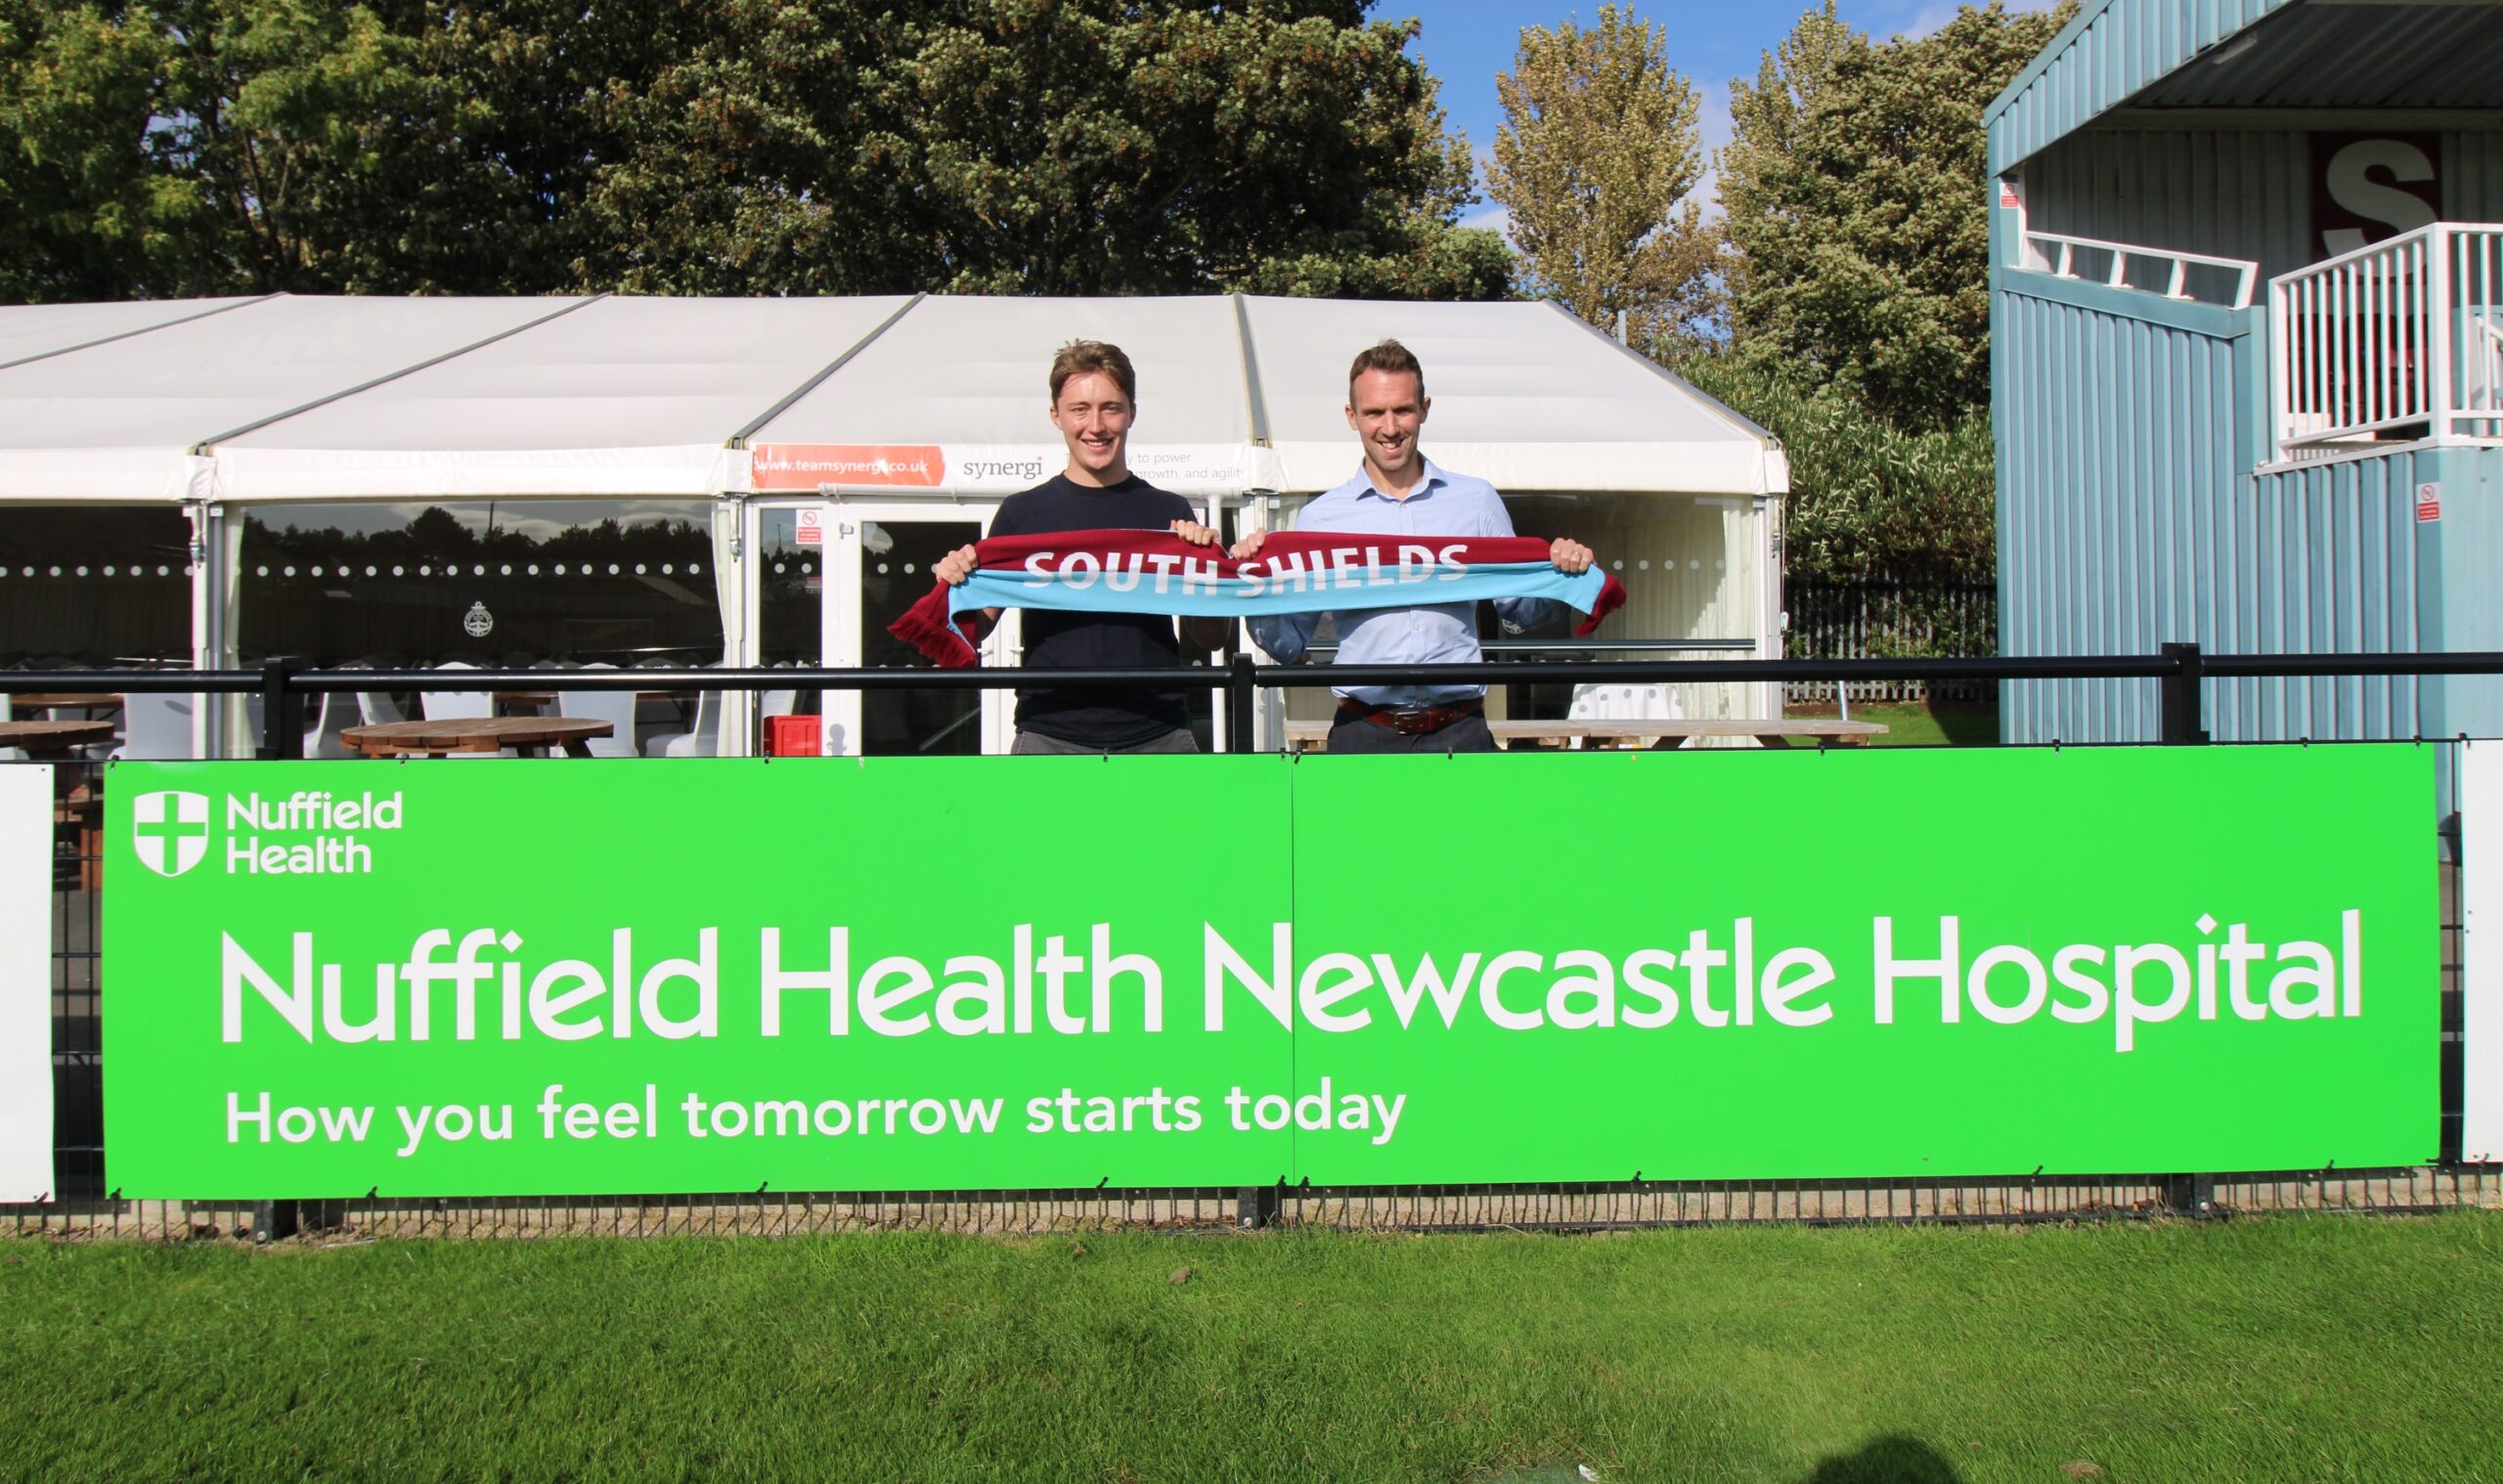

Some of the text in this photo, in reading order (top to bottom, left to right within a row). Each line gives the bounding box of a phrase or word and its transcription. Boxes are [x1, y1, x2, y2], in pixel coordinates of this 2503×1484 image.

[2322, 139, 2438, 278] S
[754, 459, 929, 475] www.teamsynergco.uk
[963, 456, 1043, 480] synergi
[1137, 454, 1150, 463] to
[1154, 455, 1192, 465] power
[1185, 467, 1208, 479] and
[1024, 545, 1469, 598] SOUTH SHIELDS
[226, 790, 403, 831] Nuffield
[226, 835, 372, 875] Health
[221, 908, 2362, 1054] Nuffield Health Newcastle Hospital
[227, 1075, 1408, 1157] How you feel tomorrow starts today
